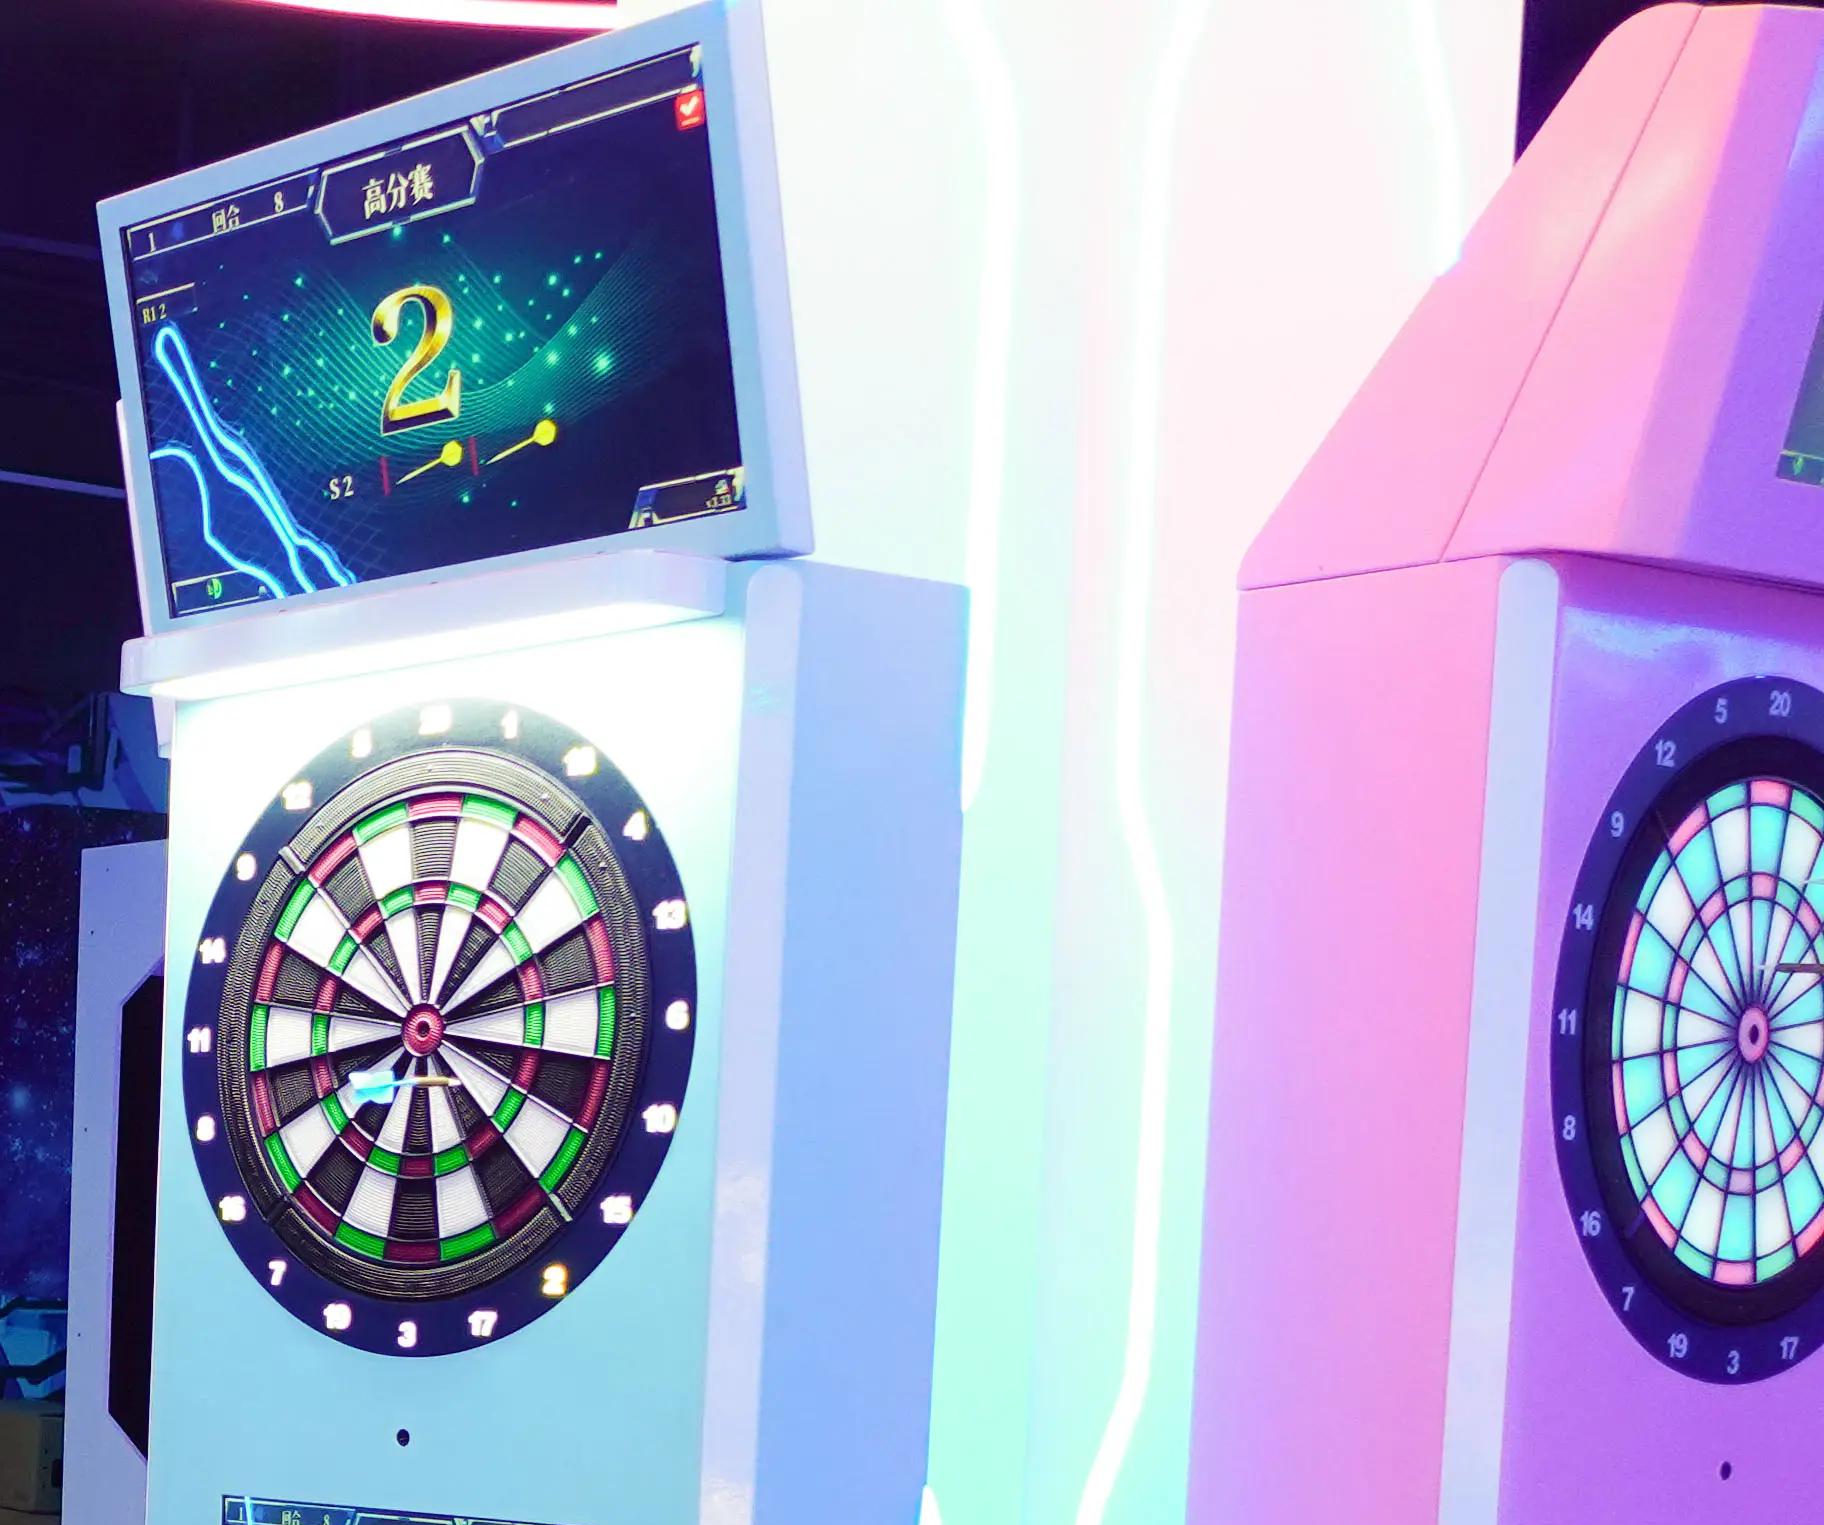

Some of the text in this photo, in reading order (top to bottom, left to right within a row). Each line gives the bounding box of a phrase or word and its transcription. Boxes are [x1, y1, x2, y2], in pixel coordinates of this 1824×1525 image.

[361, 163, 434, 220] 高分赛
[148, 191, 284, 252] 1 回合 8
[371, 286, 461, 436] 2
[1713, 697, 1730, 725] 5
[1768, 690, 1793, 717] 20
[501, 709, 520, 740] 1
[1654, 739, 1677, 768] 12
[622, 807, 650, 842] 4
[1609, 810, 1626, 838] 9
[236, 852, 257, 881] 9
[652, 898, 689, 930] 13
[1573, 902, 1595, 931] 14
[199, 937, 226, 967] 14
[665, 999, 690, 1030] 6
[1557, 1008, 1578, 1035] 11
[187, 1026, 212, 1054] 11
[196, 1115, 216, 1142] 8
[642, 1103, 677, 1134] 10
[1562, 1115, 1577, 1141] 8
[600, 1195, 633, 1224] 15
[1579, 1211, 1602, 1237] 16
[268, 1259, 288, 1286] 7
[540, 1263, 569, 1297] 2
[1621, 1286, 1635, 1312] 7
[396, 1320, 419, 1348] 3
[467, 1309, 499, 1338] 17
[1666, 1333, 1689, 1359] 19
[1779, 1336, 1800, 1360] 17
[1726, 1350, 1741, 1375] 3
